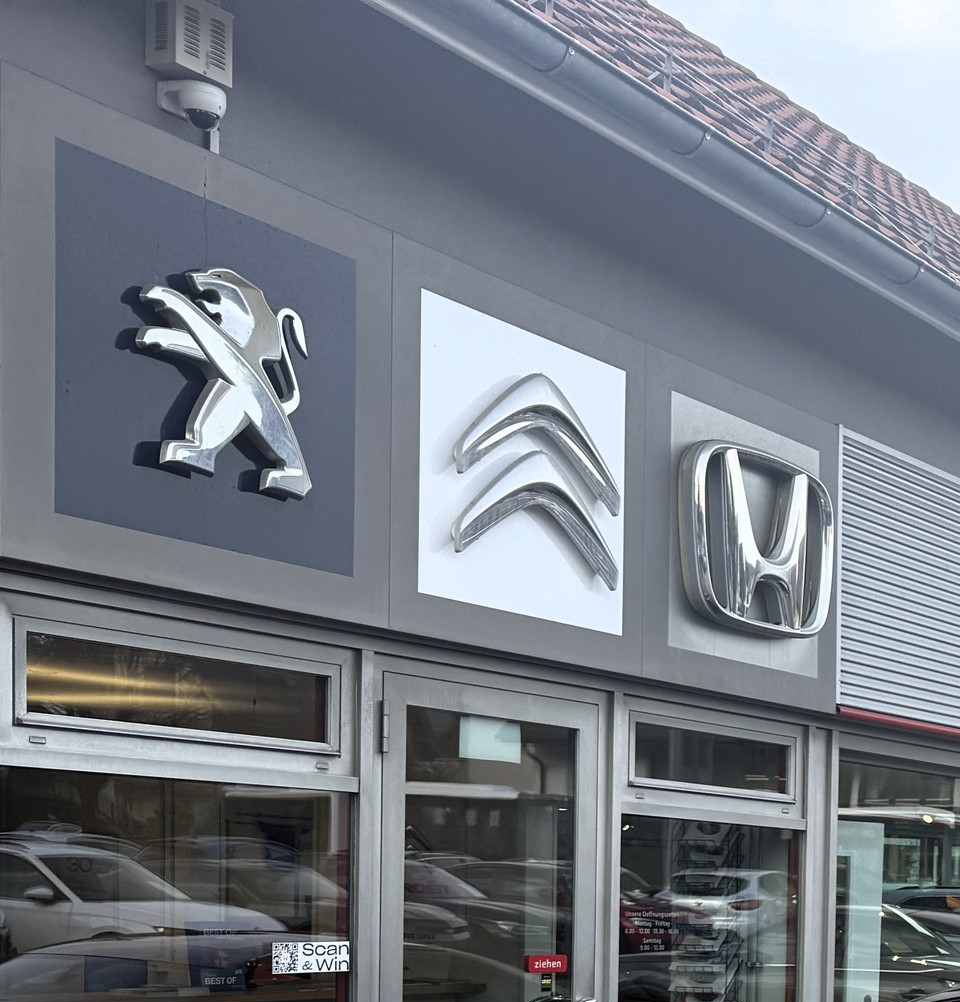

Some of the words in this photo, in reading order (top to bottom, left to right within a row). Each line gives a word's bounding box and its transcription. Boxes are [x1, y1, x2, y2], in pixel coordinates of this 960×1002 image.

[302, 943, 349, 956] Scan
[302, 961, 313, 971] &
[316, 957, 349, 971] Win
[534, 959, 562, 969] ziehen
